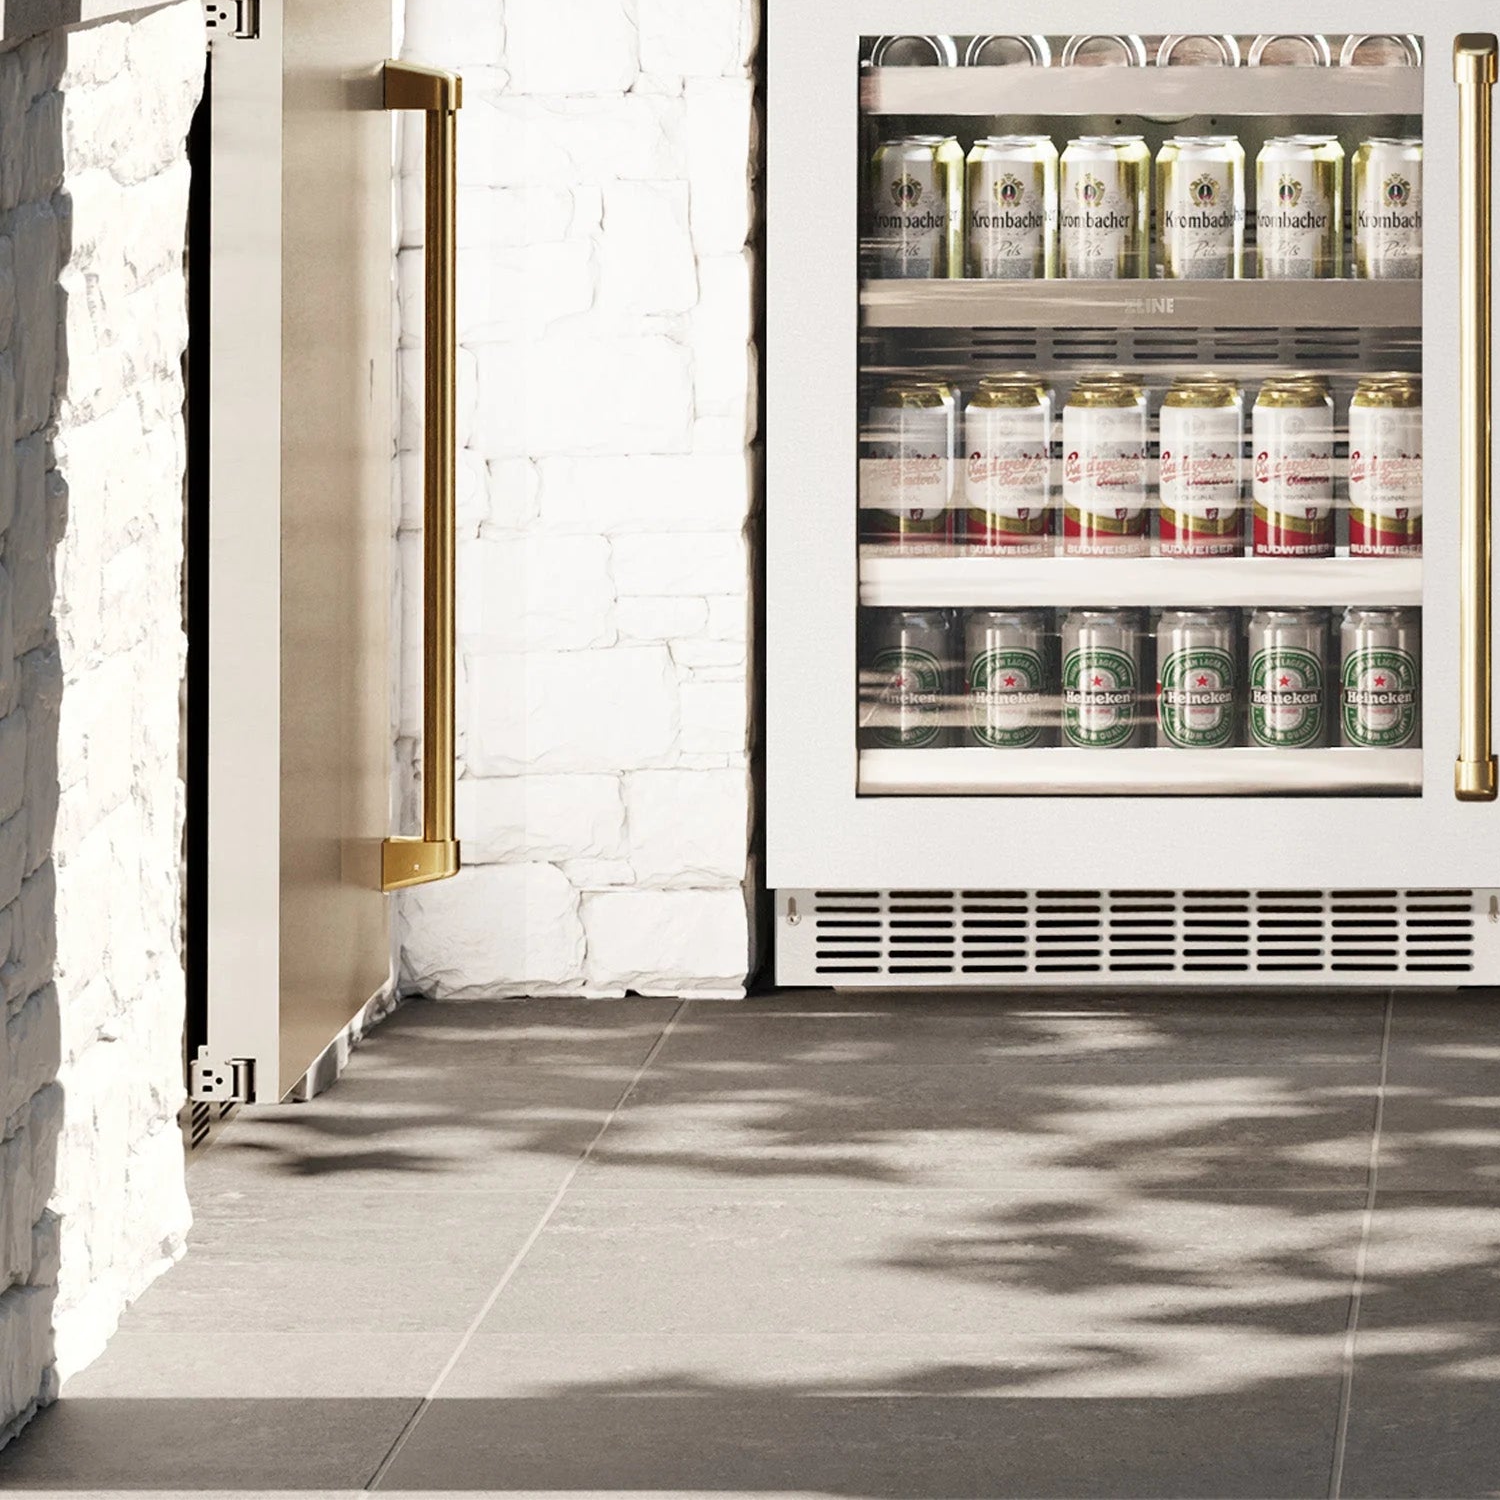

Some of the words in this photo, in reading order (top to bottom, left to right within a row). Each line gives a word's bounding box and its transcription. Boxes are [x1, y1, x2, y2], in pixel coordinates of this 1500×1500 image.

[976, 691, 1040, 704] Heineken
[1066, 690, 1131, 704] Heineken
[1167, 691, 1232, 704] Heineken
[1253, 690, 1317, 704] Heineken
[1347, 690, 1412, 704] Heineken
